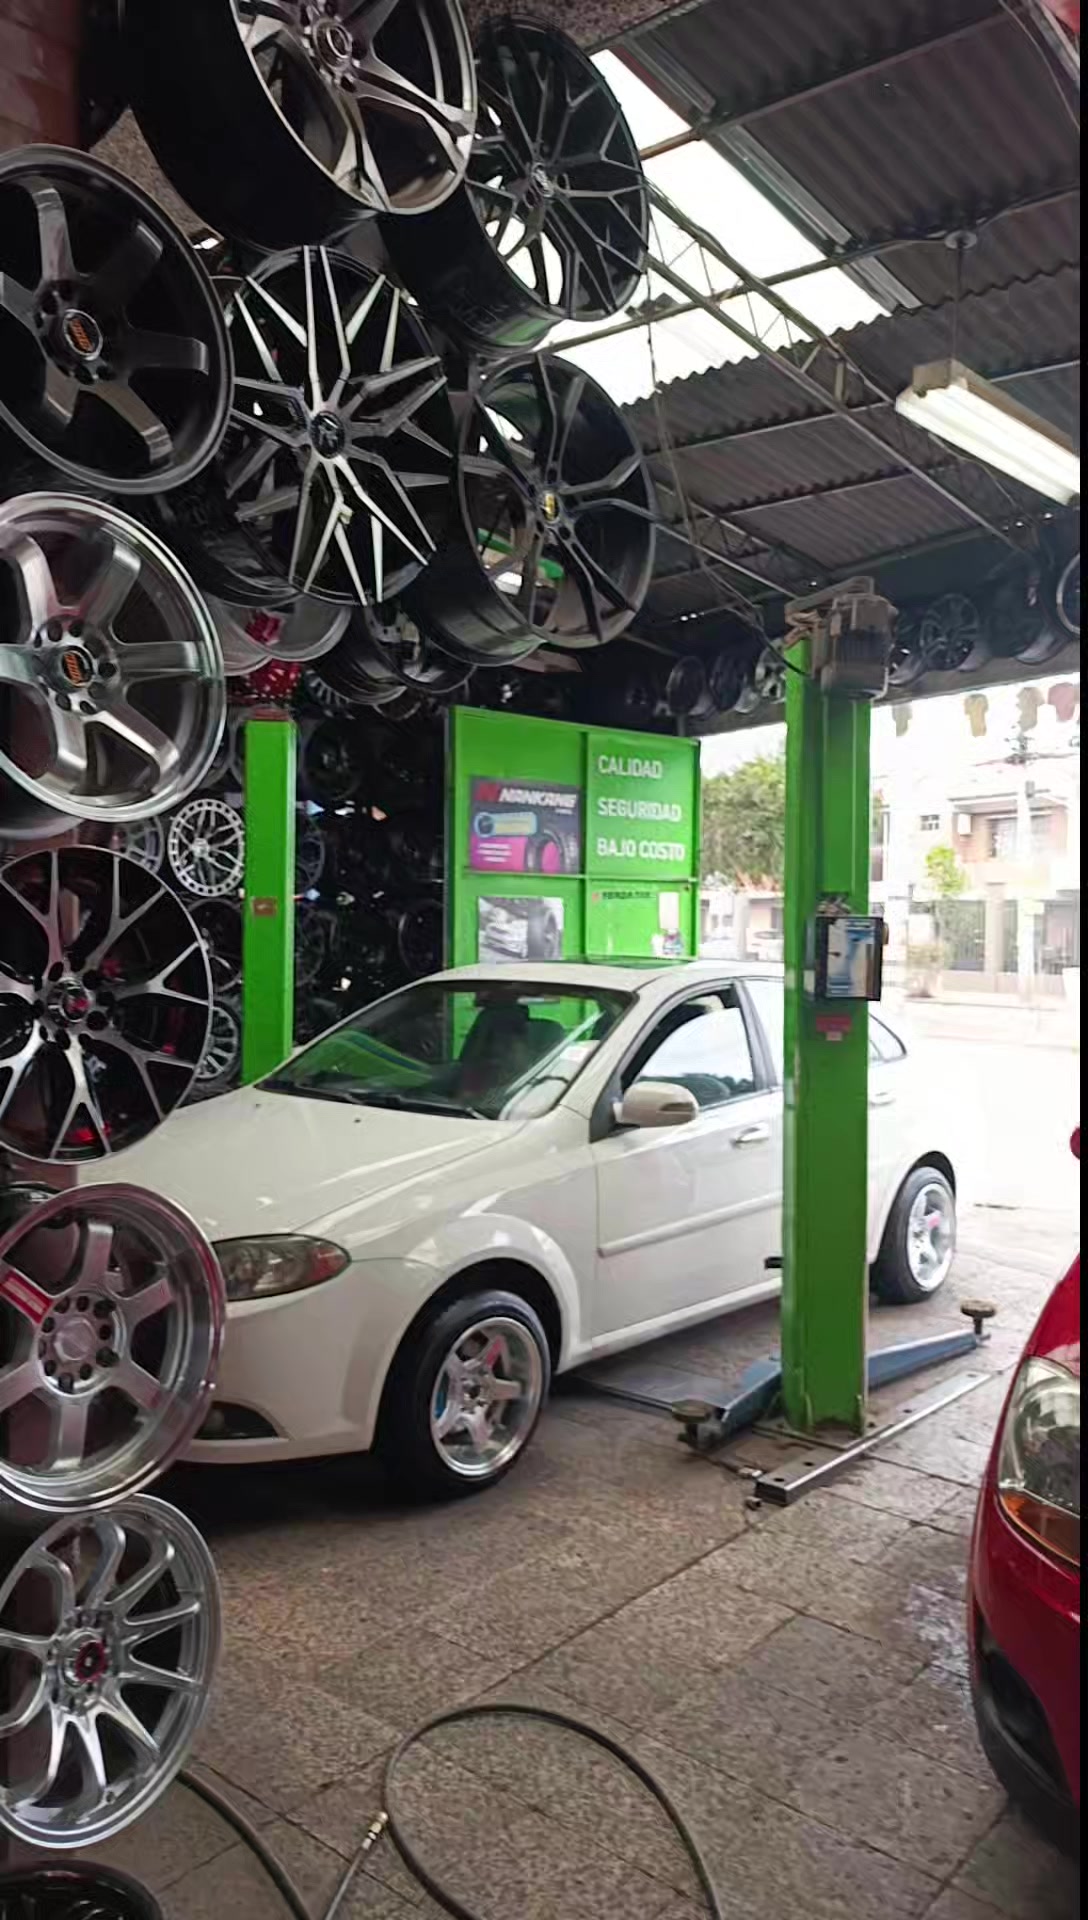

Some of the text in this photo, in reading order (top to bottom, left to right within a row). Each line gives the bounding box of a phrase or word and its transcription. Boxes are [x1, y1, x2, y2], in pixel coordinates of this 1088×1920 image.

[598, 755, 663, 779] CALIDAD
[597, 797, 682, 822] SEGURIDAD
[597, 837, 686, 862] BAJO COSTO
